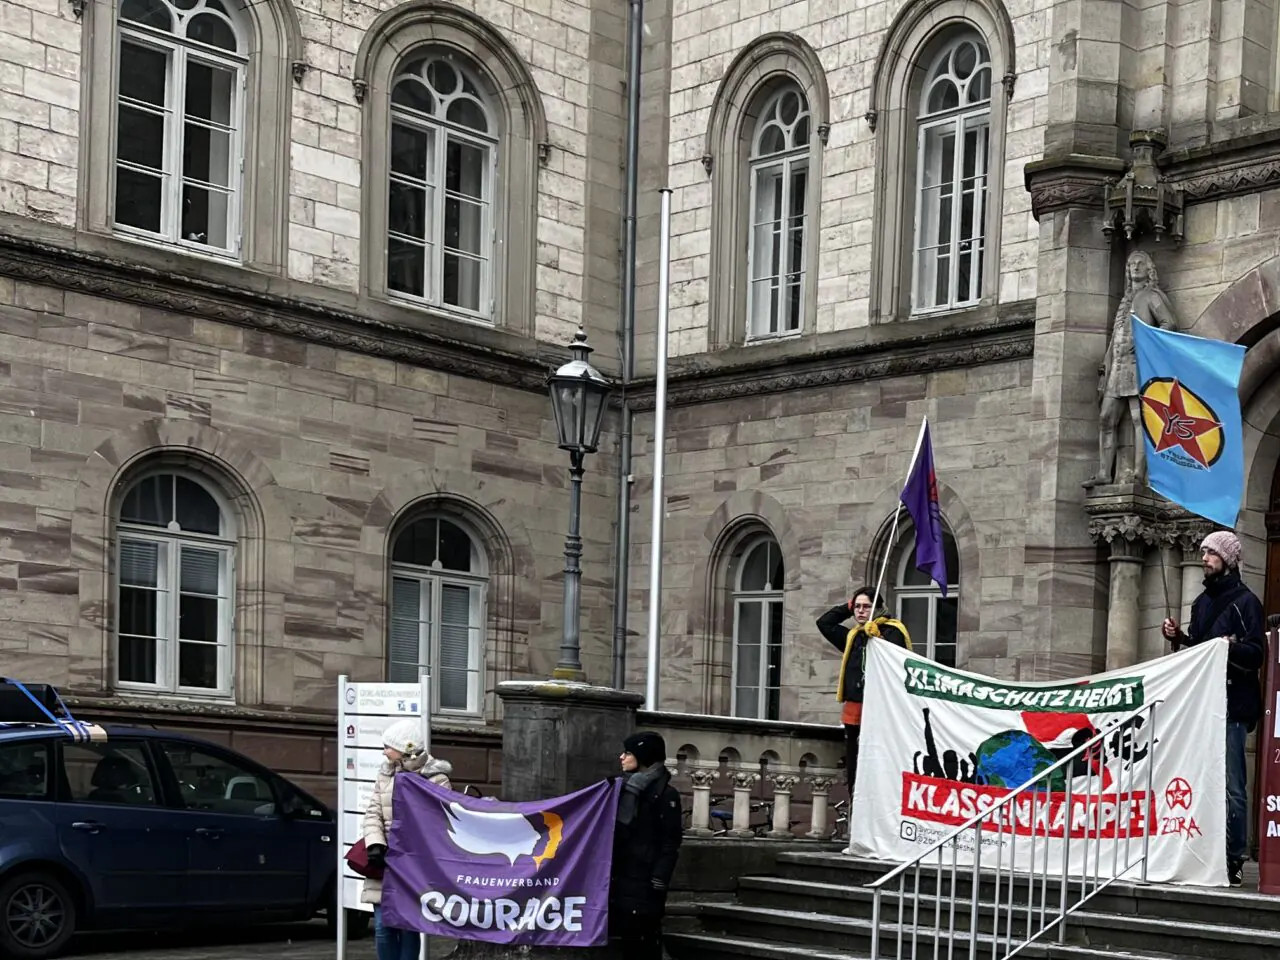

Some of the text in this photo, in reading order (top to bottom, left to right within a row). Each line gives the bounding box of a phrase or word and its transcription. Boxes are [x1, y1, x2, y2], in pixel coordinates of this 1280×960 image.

[1162, 406, 1196, 440] YS
[907, 665, 1067, 708] KLIMASCHUTZ
[1273, 748, 1280, 764] 2.
[1161, 816, 1203, 840] ZORA
[456, 874, 560, 887] FRAUENVERBAND
[420, 891, 586, 932] COURAGE
